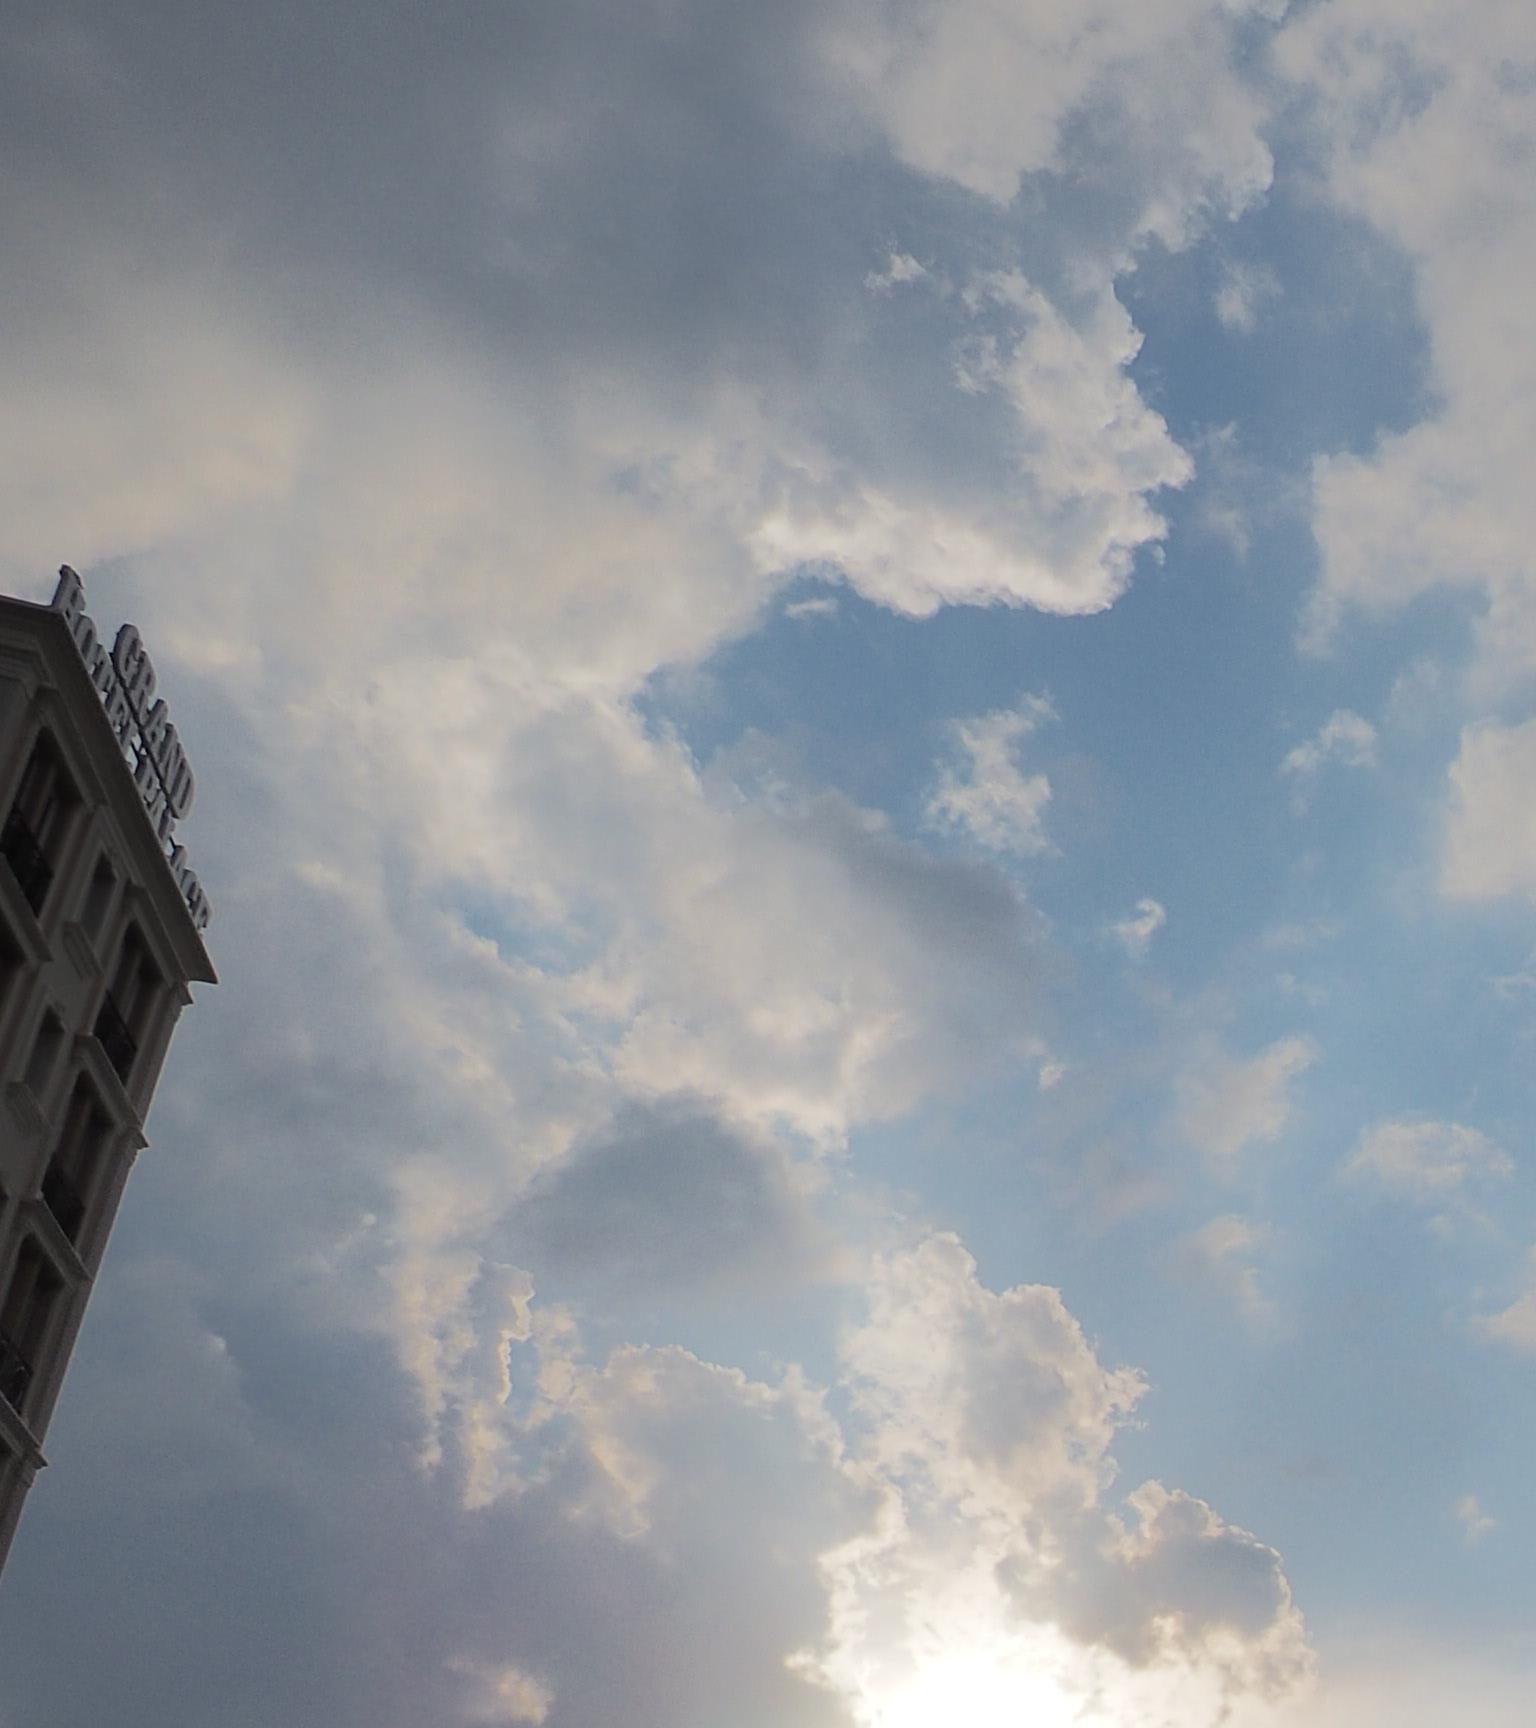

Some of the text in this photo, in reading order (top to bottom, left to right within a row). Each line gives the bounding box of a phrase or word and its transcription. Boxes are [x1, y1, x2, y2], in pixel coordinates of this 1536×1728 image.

[52, 564, 213, 933] HOTEL PALACE
[112, 623, 194, 820] GRAND
